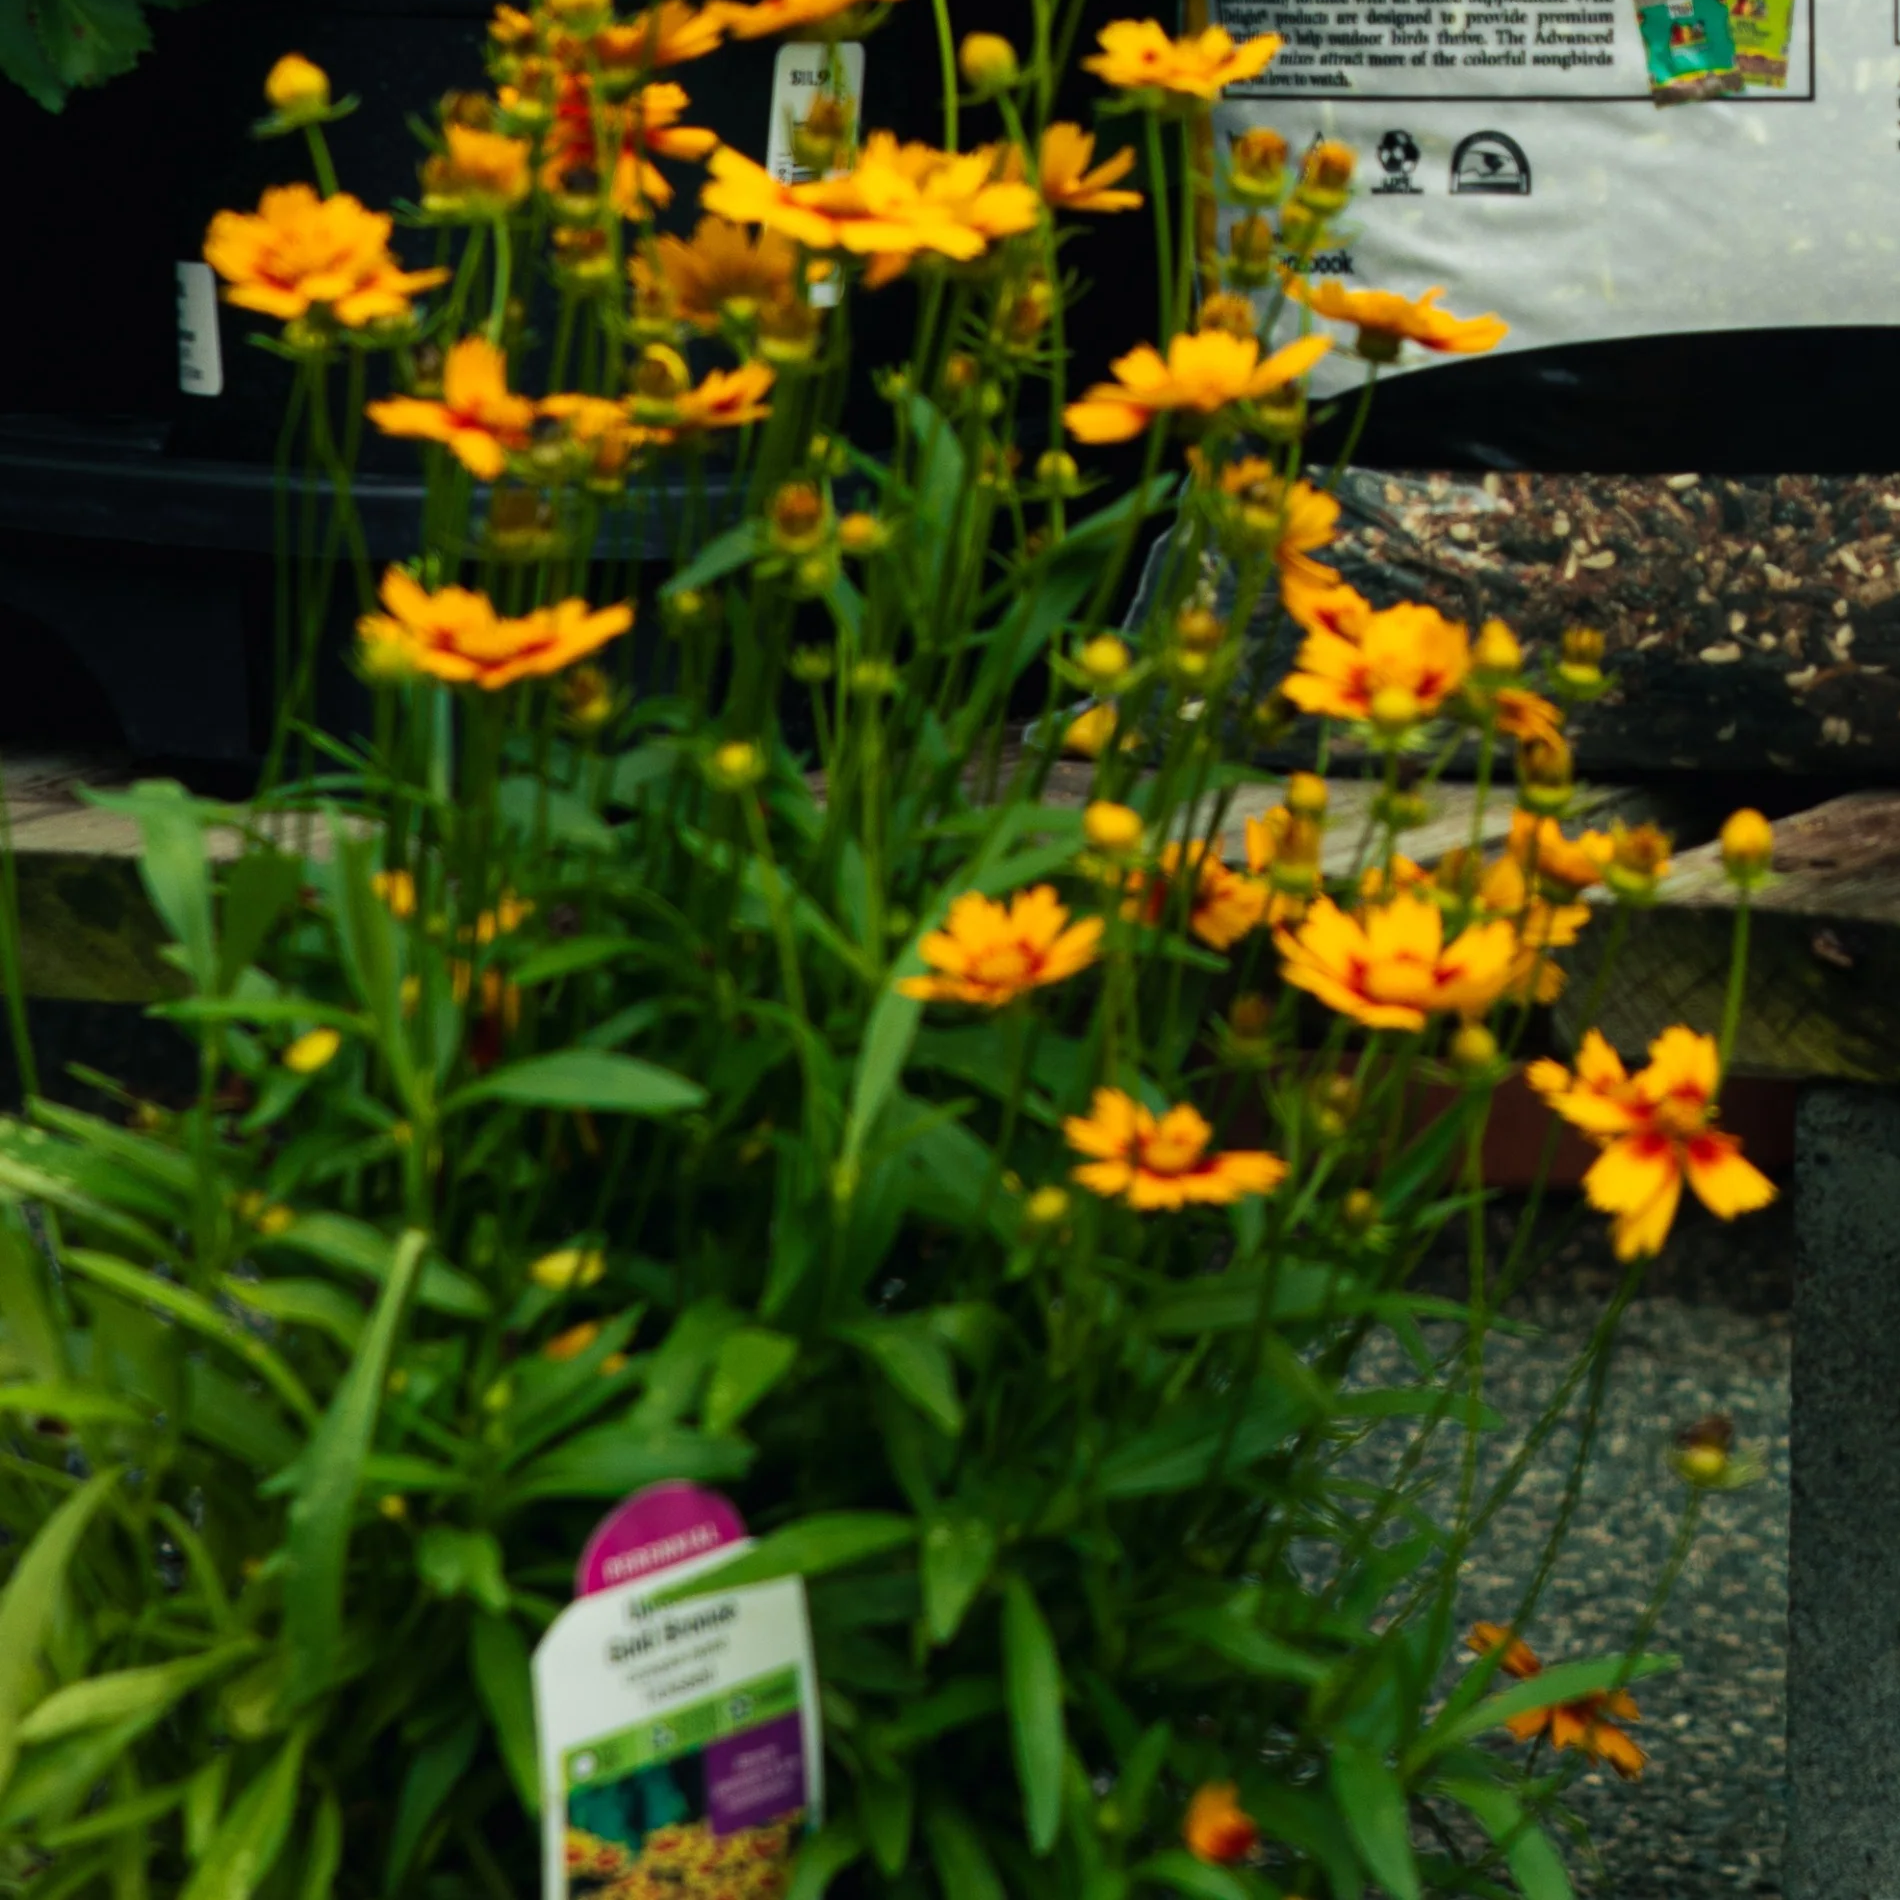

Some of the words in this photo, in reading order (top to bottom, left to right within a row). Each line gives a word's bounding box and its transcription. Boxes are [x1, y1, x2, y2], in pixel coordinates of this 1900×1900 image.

[1465, 9, 1528, 27] provide
[1537, 10, 1614, 26] premium
[1495, 31, 1527, 47] The
[1534, 30, 1614, 46] Advanced
[1463, 51, 1526, 67] colorful
[1532, 51, 1614, 70] songbirds
